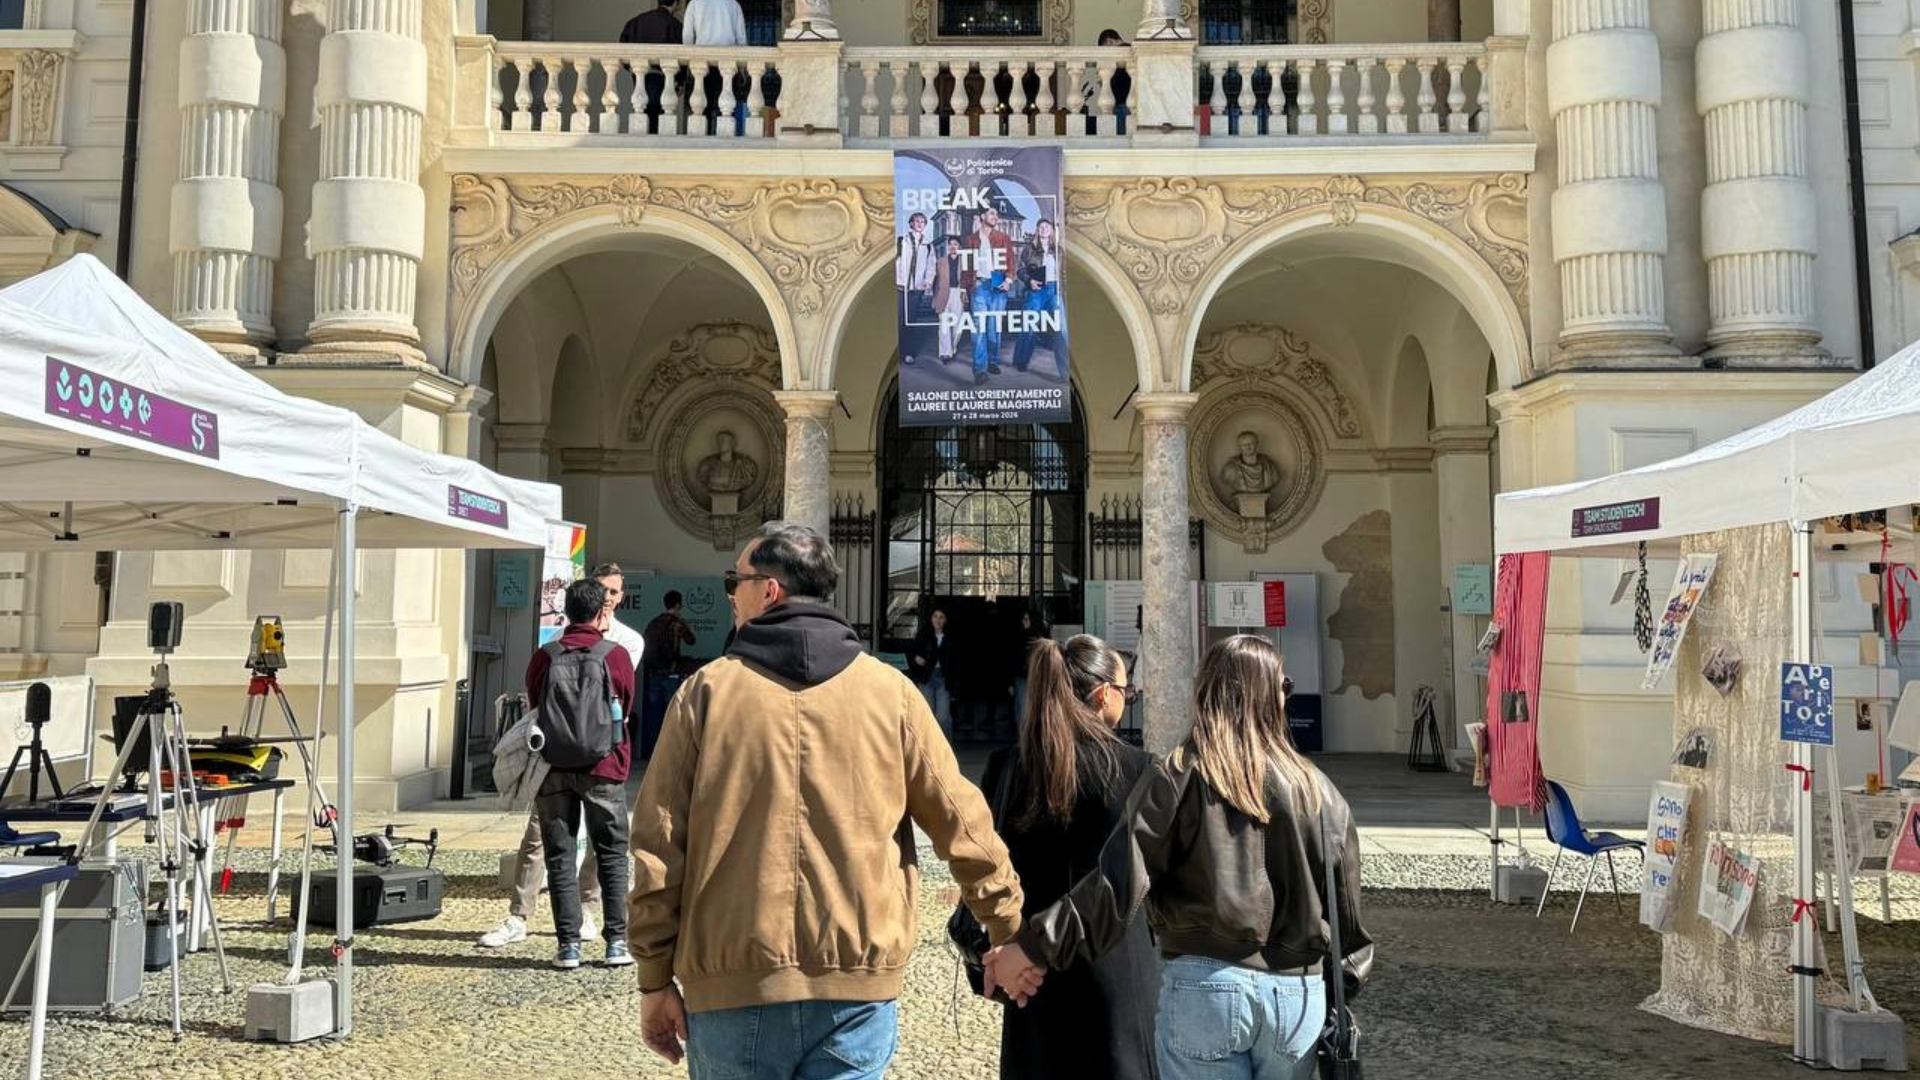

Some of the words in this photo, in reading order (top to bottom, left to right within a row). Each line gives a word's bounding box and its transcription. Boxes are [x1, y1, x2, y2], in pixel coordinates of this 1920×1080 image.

[967, 159, 1013, 167] Politecnico
[967, 167, 976, 175] di
[977, 167, 1004, 175] Torino
[902, 187, 990, 210] BREAK
[957, 248, 1008, 271] THE
[940, 310, 1061, 334] PATTERN
[907, 391, 949, 401] SALONE
[951, 389, 1062, 400] DELL'ORIENTAMENTO
[908, 401, 947, 412] LAUREE
[949, 401, 955, 411] E
[956, 400, 995, 410] LAUREE
[997, 399, 1062, 410] MAGISTRALI
[1000, 411, 1018, 419] 2026
